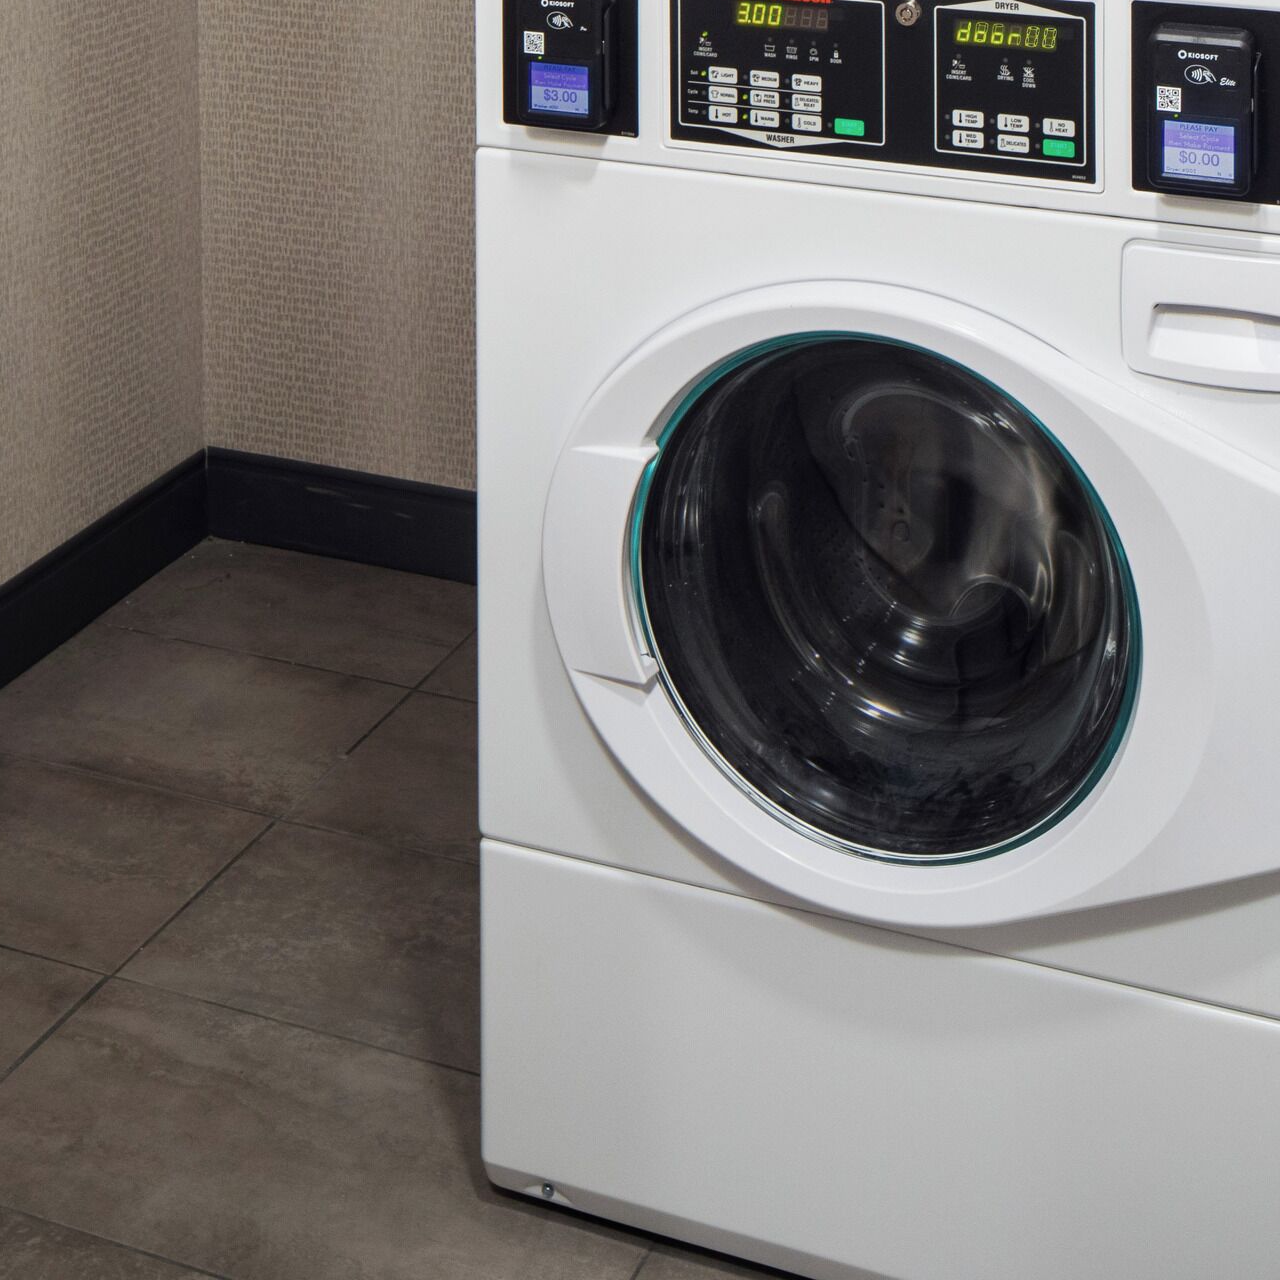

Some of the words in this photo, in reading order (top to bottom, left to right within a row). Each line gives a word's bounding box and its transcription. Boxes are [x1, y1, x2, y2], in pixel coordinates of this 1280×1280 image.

[995, 2, 1019, 10] DRYER
[738, 2, 782, 25] 3.00
[1188, 52, 1218, 61] KIOSOFT
[1220, 78, 1236, 86] Elite
[544, 89, 577, 103] $3.00
[766, 134, 794, 144] WASHER
[1203, 134, 1219, 142] Cycle
[1179, 150, 1220, 166] $0.00
